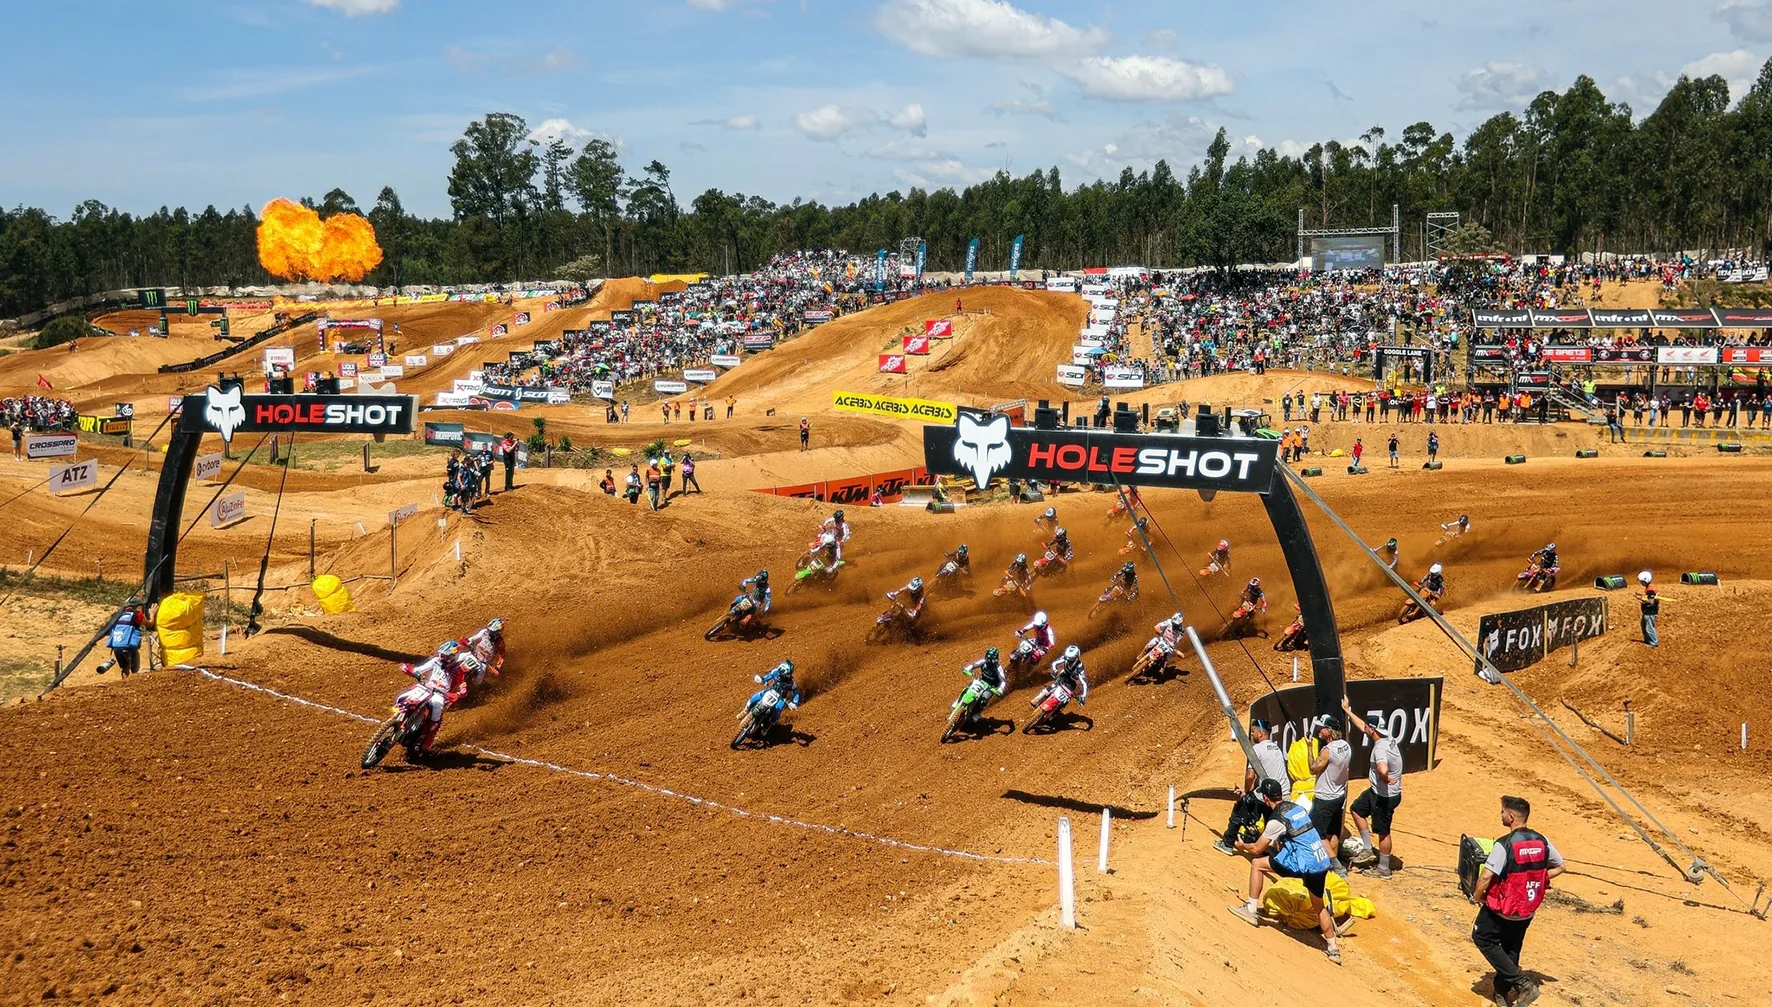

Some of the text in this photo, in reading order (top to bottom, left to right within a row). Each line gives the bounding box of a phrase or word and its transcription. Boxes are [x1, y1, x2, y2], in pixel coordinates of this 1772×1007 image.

[256, 403, 402, 426] HOLESHOT
[29, 438, 76, 450] CROSSPRO
[1028, 443, 1259, 479] HOLESHOT
[61, 464, 89, 484] ATZ
[830, 483, 870, 503] KTM
[1505, 614, 1602, 652] FOX FOX
